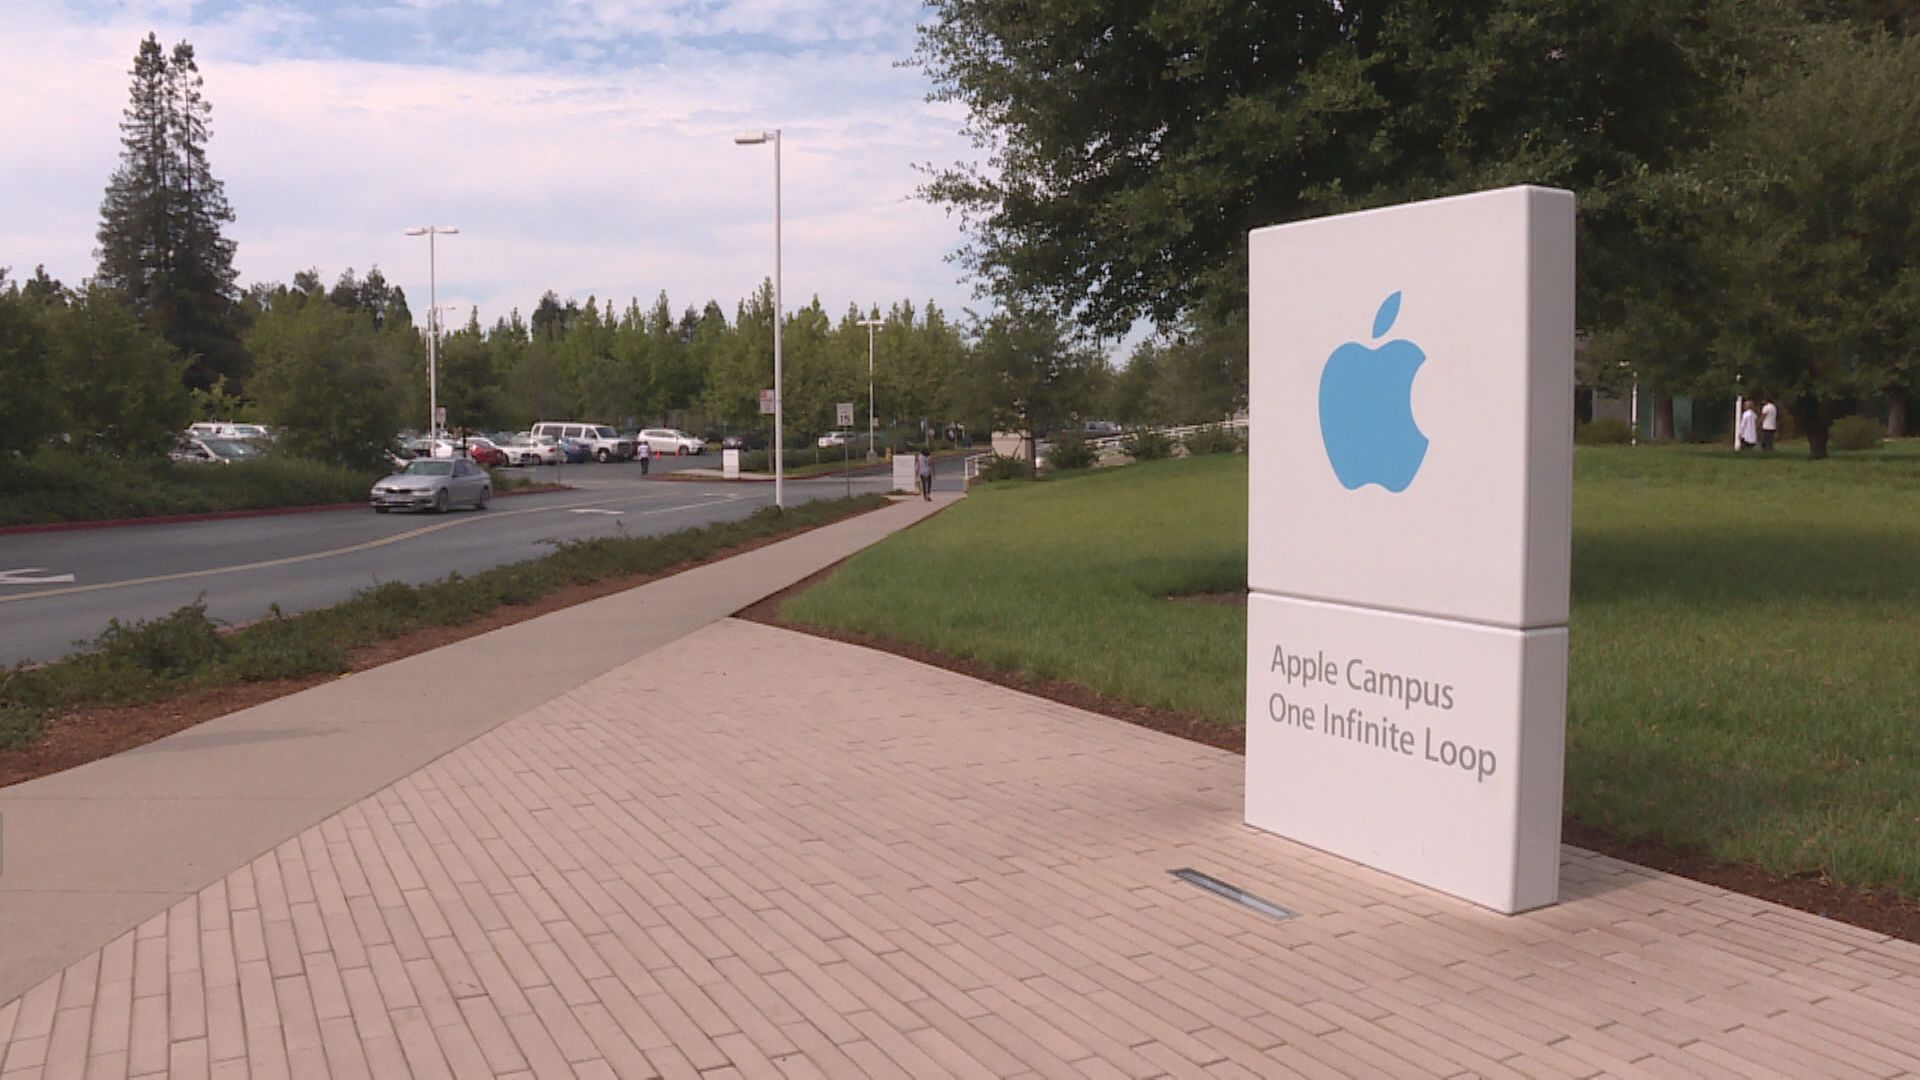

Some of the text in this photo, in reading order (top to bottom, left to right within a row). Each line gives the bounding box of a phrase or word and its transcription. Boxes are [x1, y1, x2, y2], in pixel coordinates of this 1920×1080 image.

[1270, 644, 1454, 711] Apple Campus
[1268, 692, 1497, 784] One Infinite Loop
